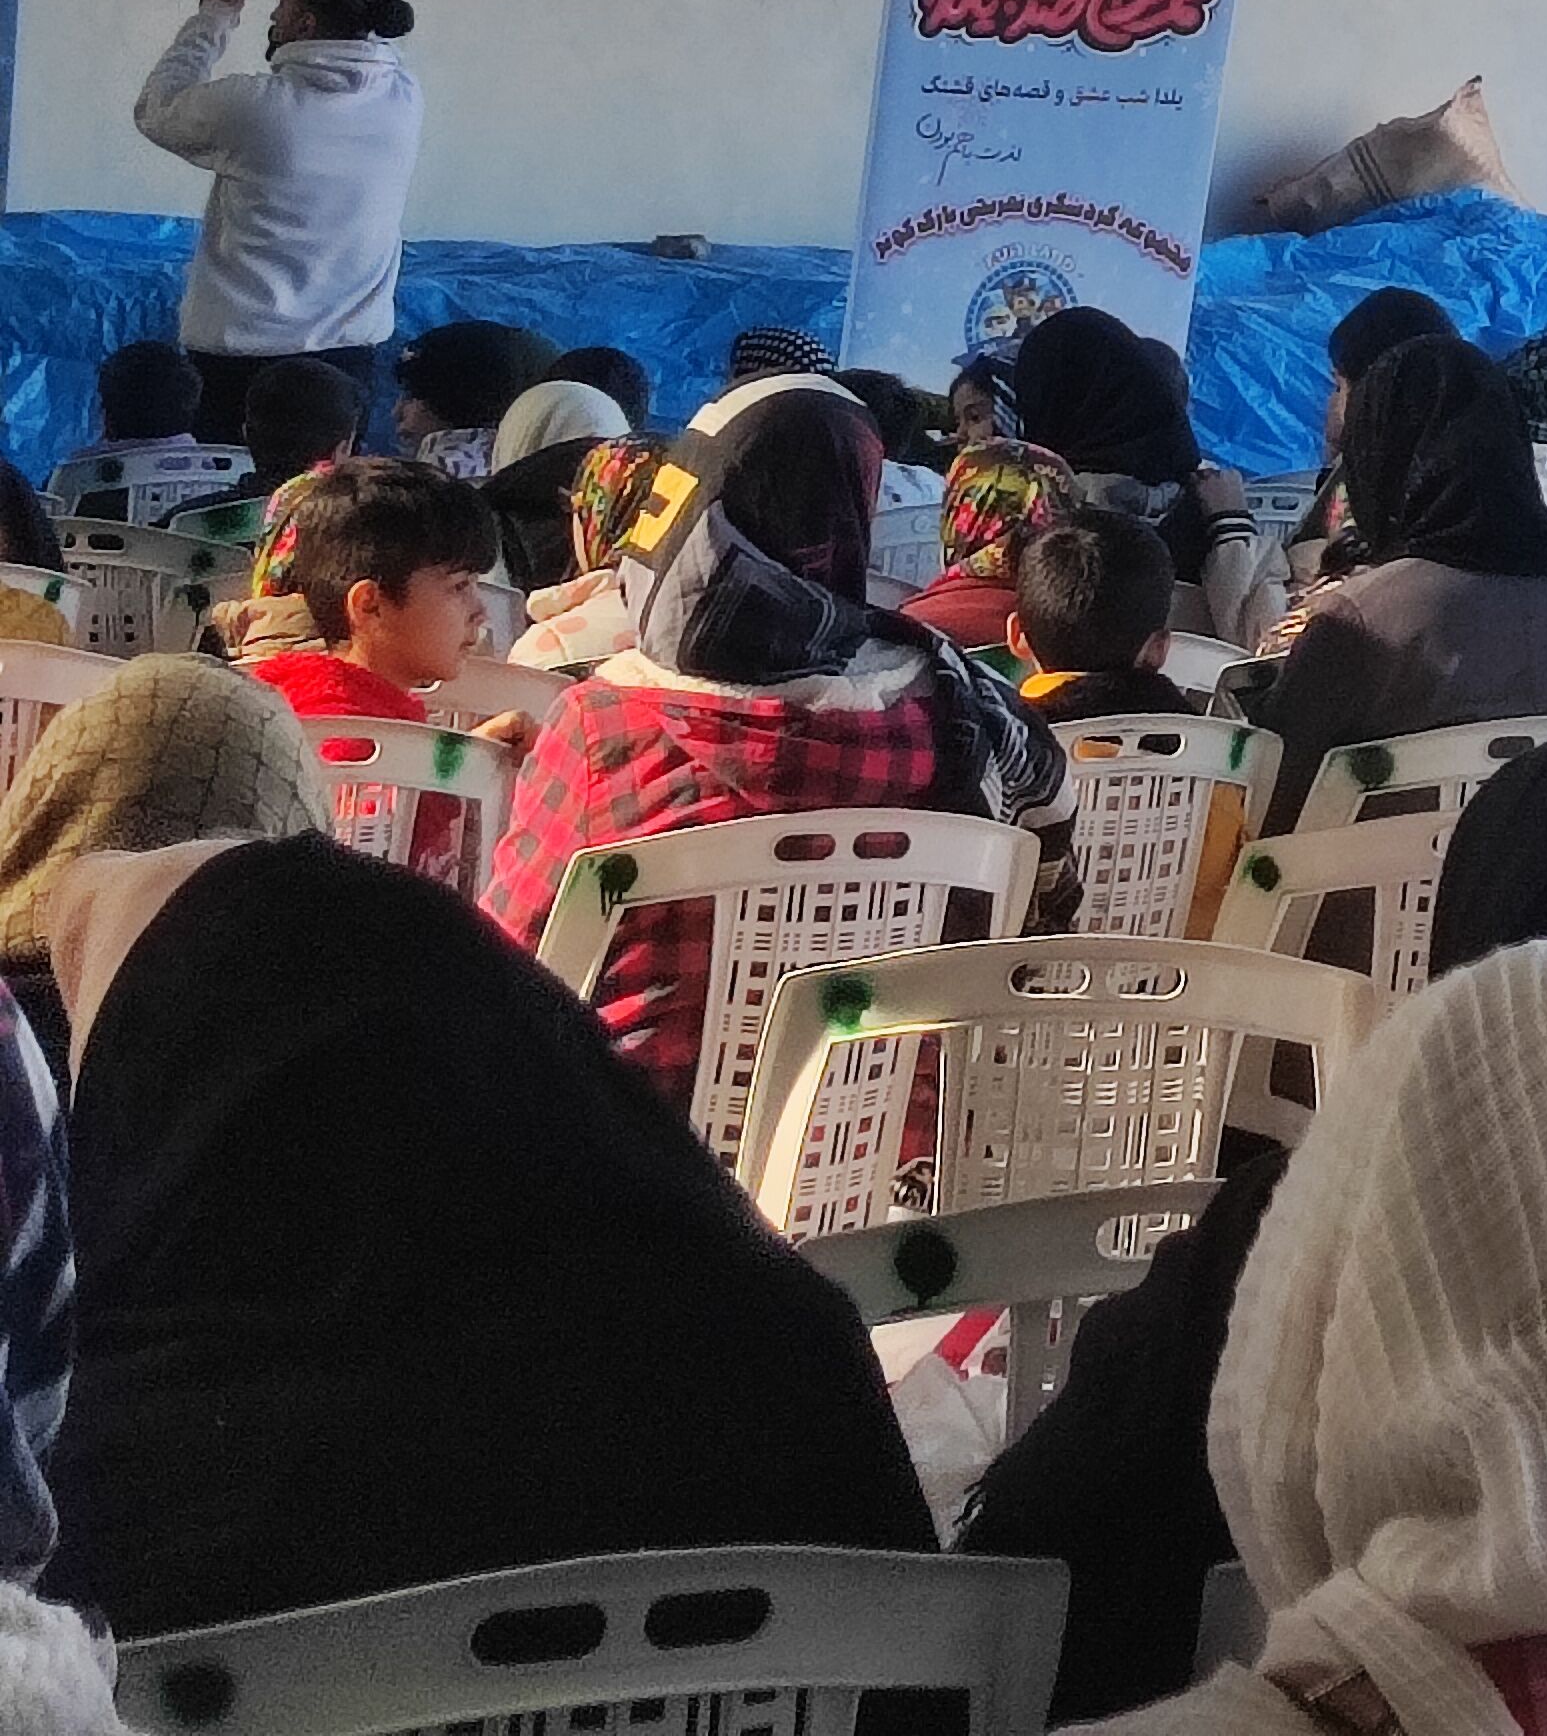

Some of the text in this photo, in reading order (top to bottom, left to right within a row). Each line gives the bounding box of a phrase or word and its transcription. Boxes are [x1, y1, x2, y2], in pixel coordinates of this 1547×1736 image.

[919, 74, 976, 96] قشنگ
[1067, 84, 1111, 107] عشق
[1052, 88, 1065, 106] و
[1115, 88, 1150, 110] شب
[1153, 87, 1184, 112] یلدا
